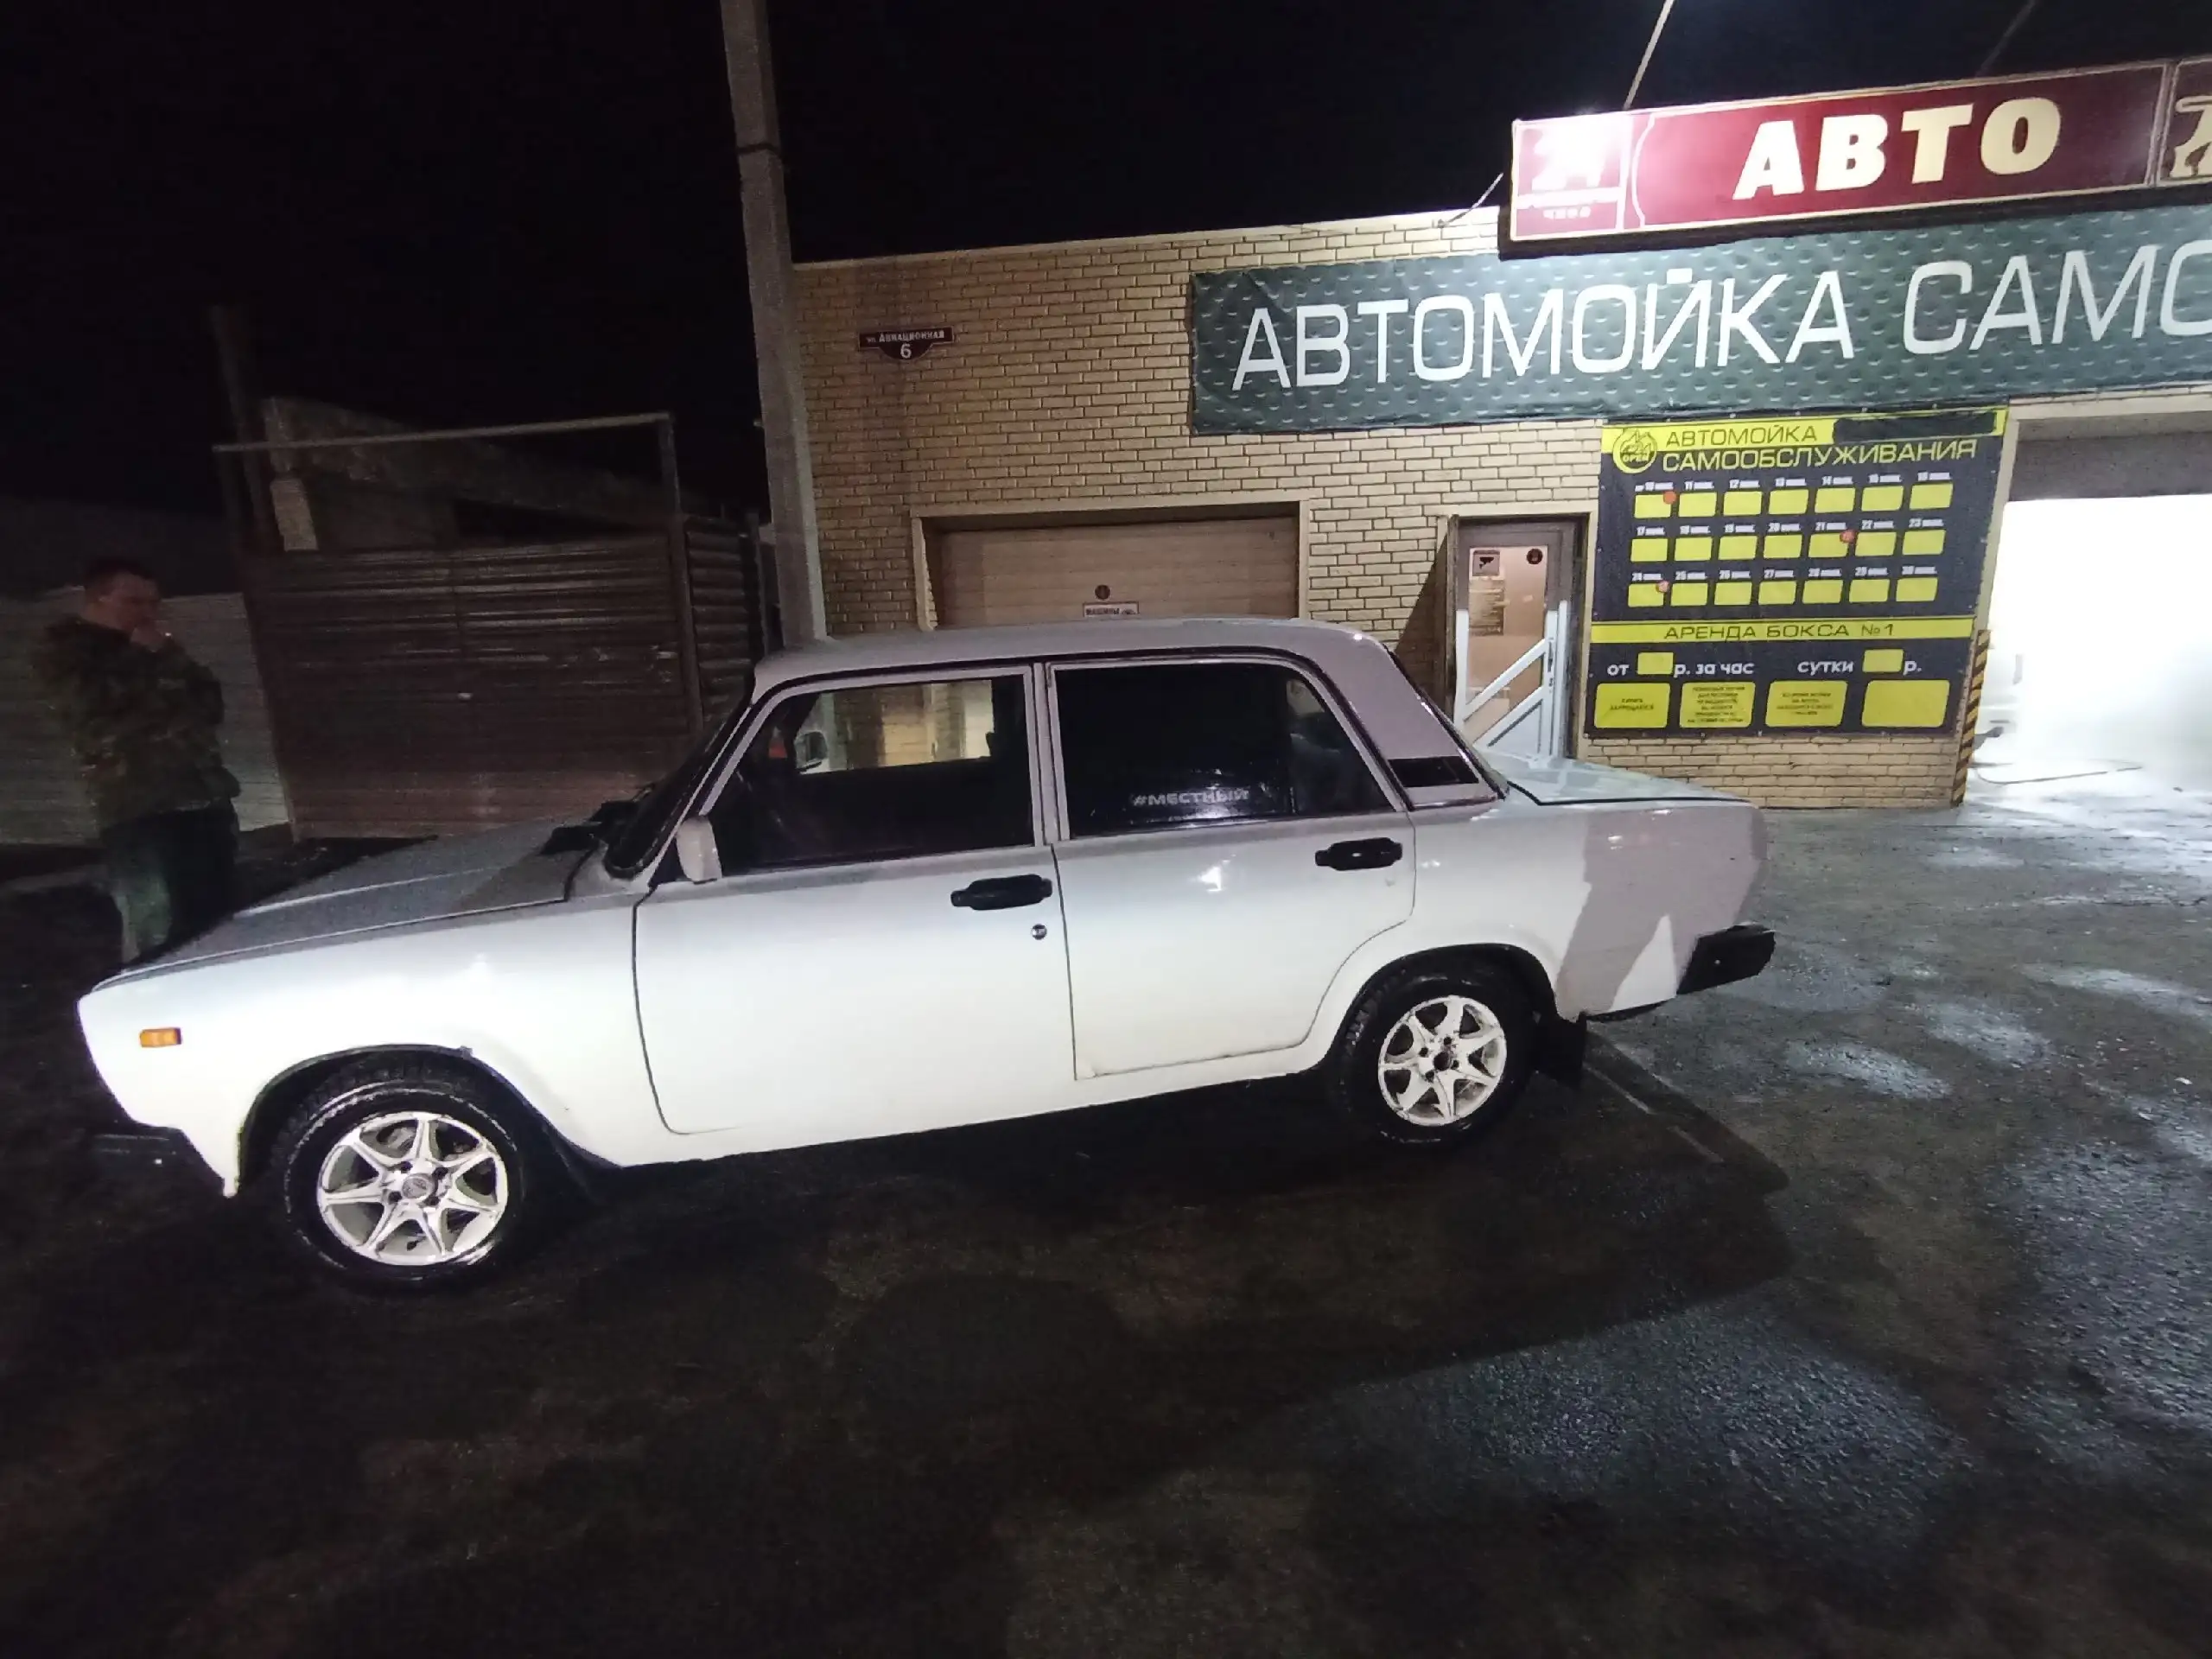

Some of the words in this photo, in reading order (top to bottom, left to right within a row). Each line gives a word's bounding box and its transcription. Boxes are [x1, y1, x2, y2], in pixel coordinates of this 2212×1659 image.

[1732, 97, 2062, 200] АВТО
[1231, 267, 1855, 391] АВТОМОЙКА
[899, 343, 912, 359] 6
[1666, 424, 1817, 448] АВТОМОЙКА
[1662, 440, 1977, 472] САМООБСЛУЖИВАНИЯ
[1663, 626, 1757, 641] АРЕНДА
[1766, 623, 1850, 638] БОКСА
[1606, 664, 1629, 676] от
[1673, 664, 1691, 677] р.
[1695, 664, 1716, 675] за
[1719, 663, 1755, 675] час
[1796, 661, 1854, 676] сутки
[1903, 660, 1923, 675] р.
